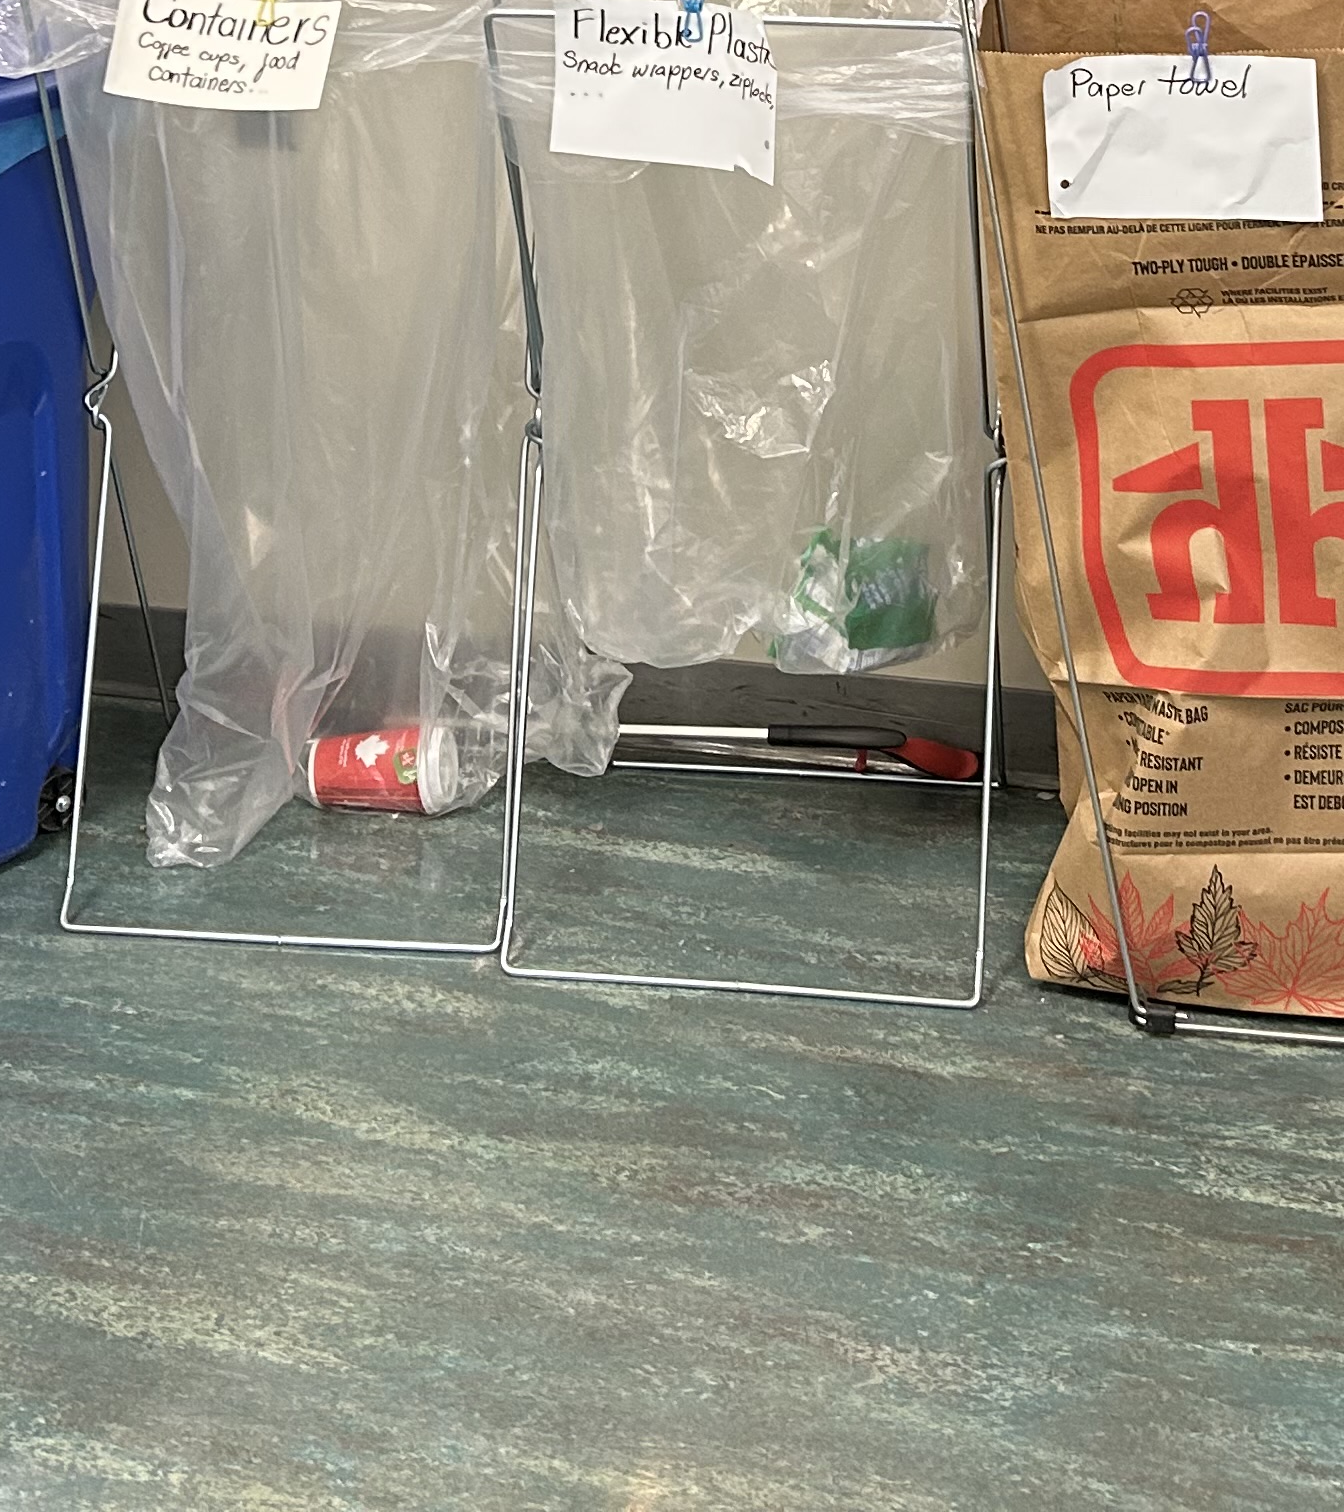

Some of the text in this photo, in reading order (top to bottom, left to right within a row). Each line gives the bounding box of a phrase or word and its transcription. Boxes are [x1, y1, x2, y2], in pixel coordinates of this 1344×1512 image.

[137, 31, 191, 60] Coffee
[253, 51, 301, 83] food
[562, 50, 623, 76] Snack
[632, 64, 725, 90] wrappers,
[1070, 64, 1252, 112] Paper towel
[1035, 224, 1047, 235] NE
[1048, 224, 1066, 235] PAS
[1067, 224, 1105, 235] REMPLIR
[1146, 223, 1157, 233] DE
[1159, 222, 1187, 233] CETTE
[1188, 222, 1215, 232] LIGNE
[1216, 220, 1242, 231] POUR
[1132, 259, 1184, 276] TWO-PLY
[1187, 256, 1228, 273] TOUGH
[1241, 254, 1290, 270] DOUBLE
[1302, 287, 1329, 295] EXIST
[1185, 705, 1209, 725] BAG
[1284, 702, 1309, 714] SAC
[1311, 701, 1344, 713] POUR
[1294, 742, 1343, 760] RÉSISTE
[1139, 751, 1203, 771] RESISTANT
[1132, 775, 1163, 794] OPEN
[1166, 779, 1178, 794] IN
[1134, 801, 1188, 817] POSITION
[1293, 794, 1316, 810] EST
[1163, 830, 1181, 839] may
[1184, 829, 1197, 838] not
[1231, 828, 1250, 838] your
